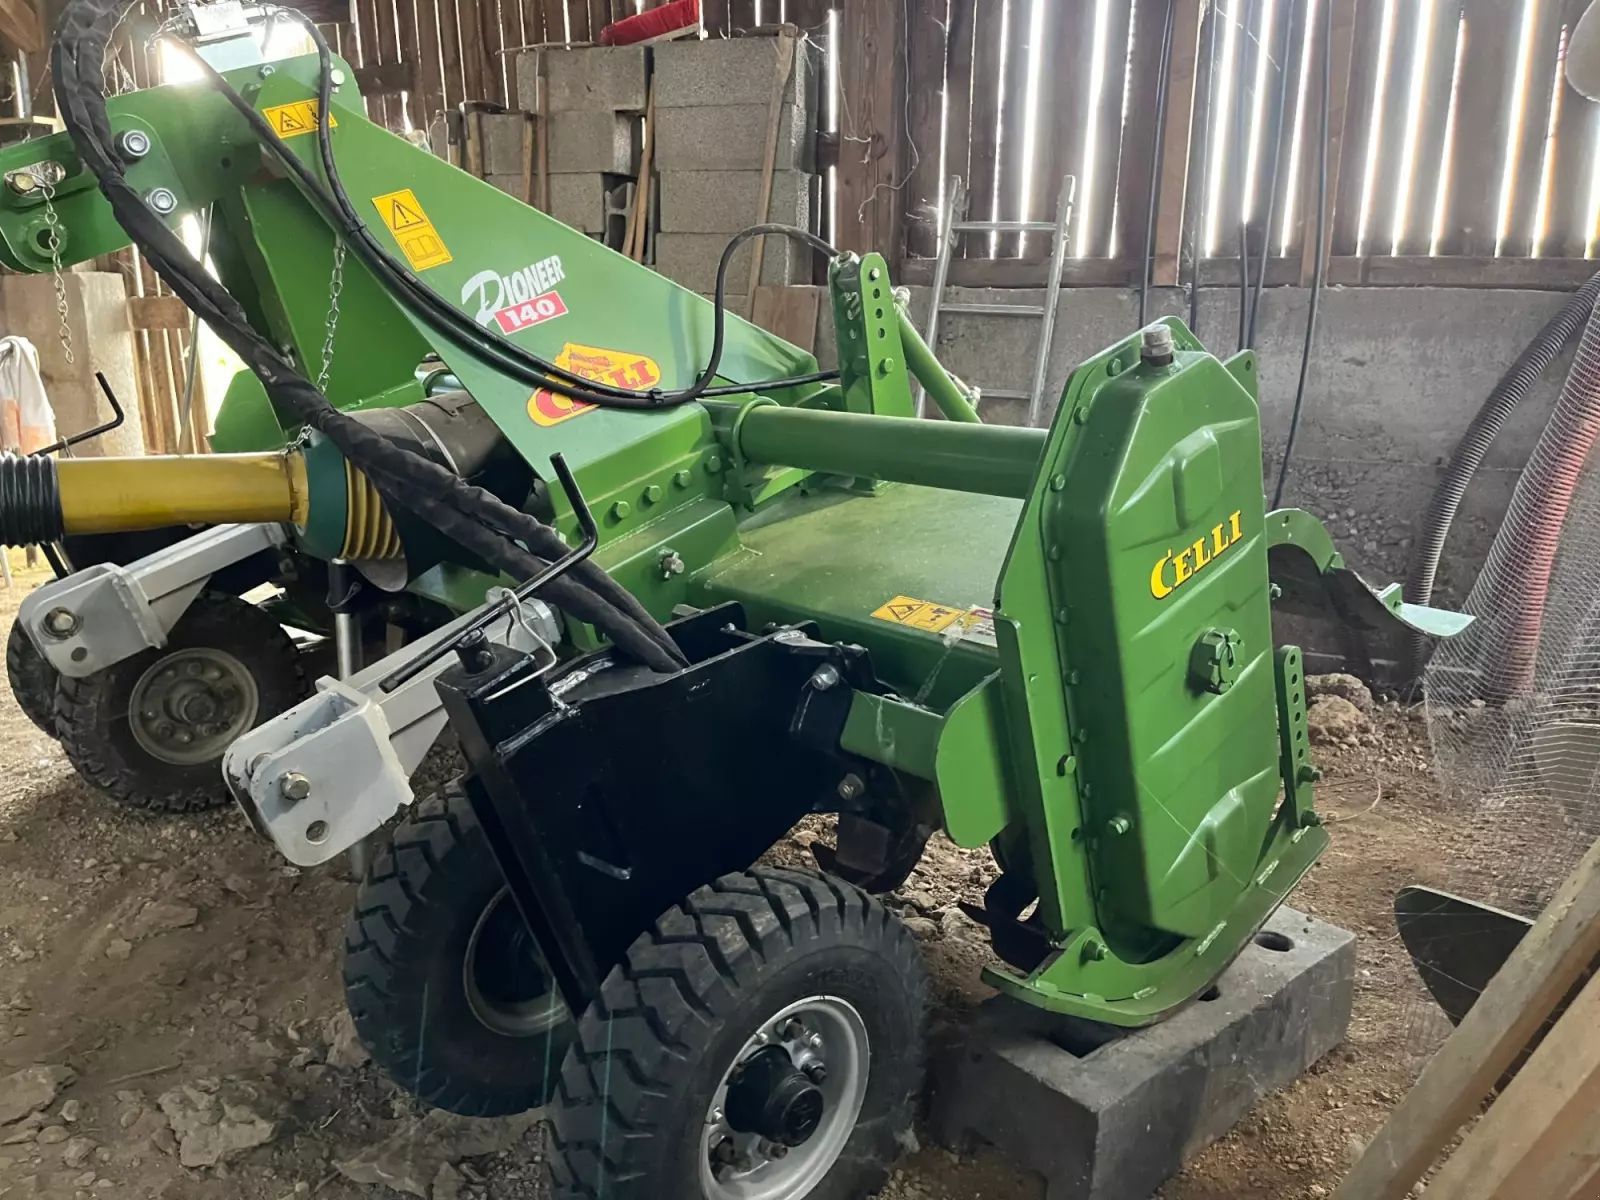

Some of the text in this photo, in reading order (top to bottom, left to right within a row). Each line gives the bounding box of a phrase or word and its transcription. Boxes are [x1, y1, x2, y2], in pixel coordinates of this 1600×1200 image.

[461, 255, 565, 328] PIONEER
[504, 300, 556, 328] 140
[535, 360, 655, 419] CLI
[1150, 510, 1243, 600] CELLI
